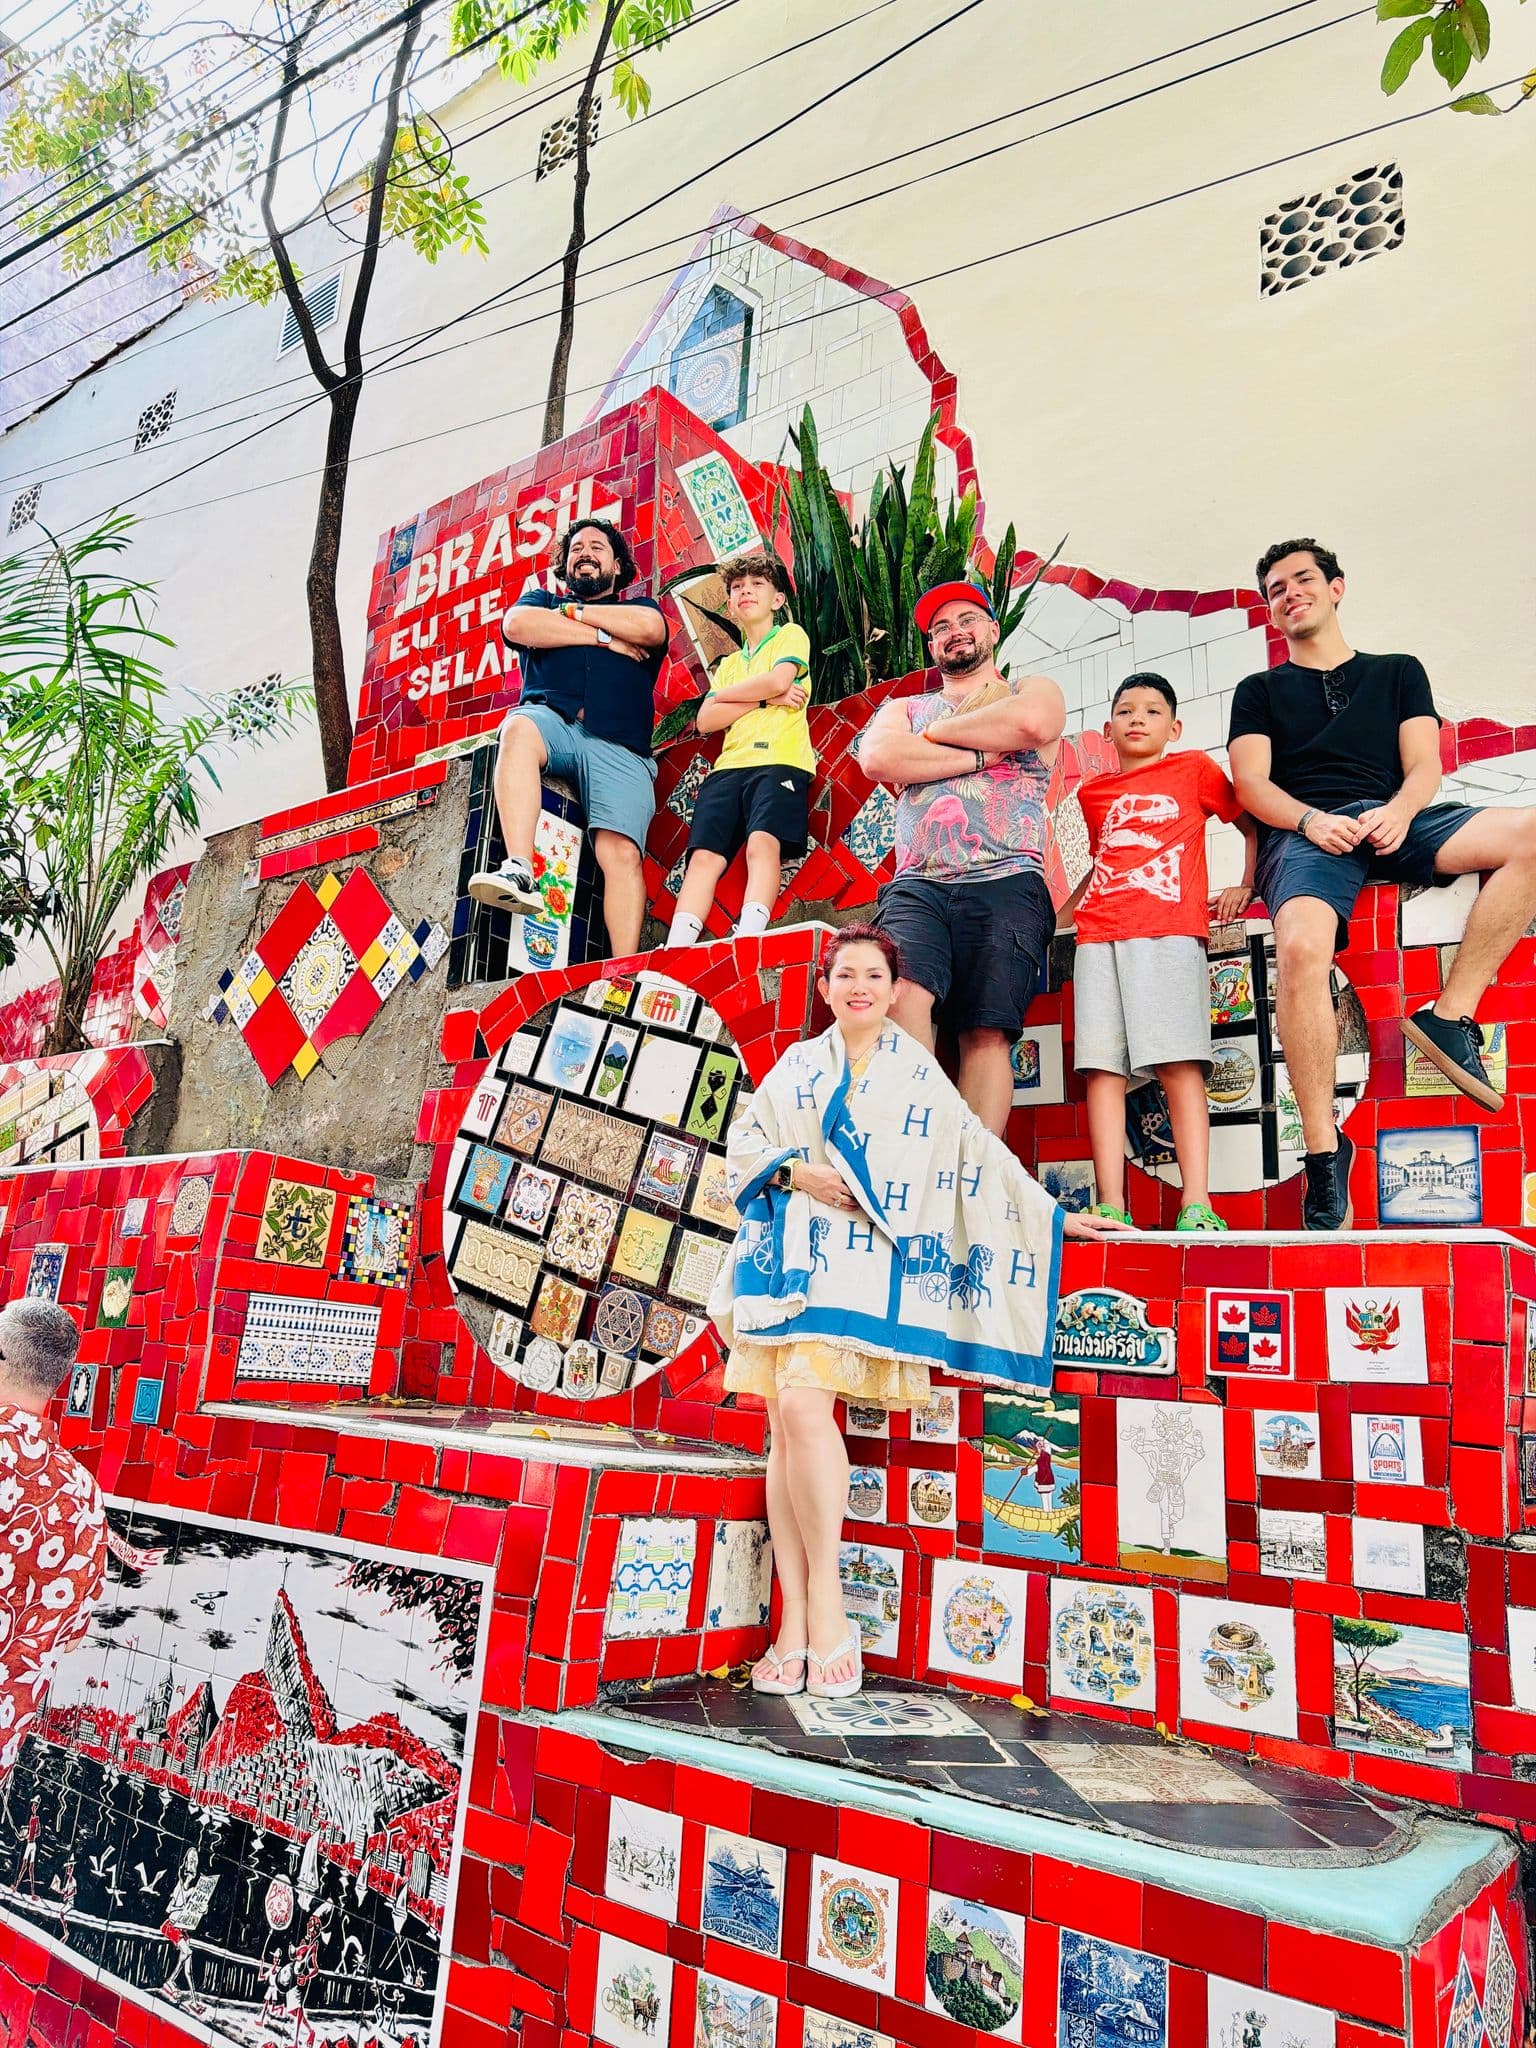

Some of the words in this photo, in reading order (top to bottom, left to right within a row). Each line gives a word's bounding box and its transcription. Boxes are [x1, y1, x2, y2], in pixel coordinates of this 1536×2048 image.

[394, 477, 623, 620] BRASIL
[389, 615, 438, 663] EU
[452, 589, 505, 634] TE
[1219, 959, 1243, 968] Tobago
[1052, 1326, 1146, 1366] ้านมั่งมีศรีสุข
[1246, 1364, 1282, 1373] Canada
[1381, 1422, 1400, 1434] LOUIS
[1373, 1459, 1402, 1473] SPORTS
[1381, 1746, 1414, 1760] NAPOLI
